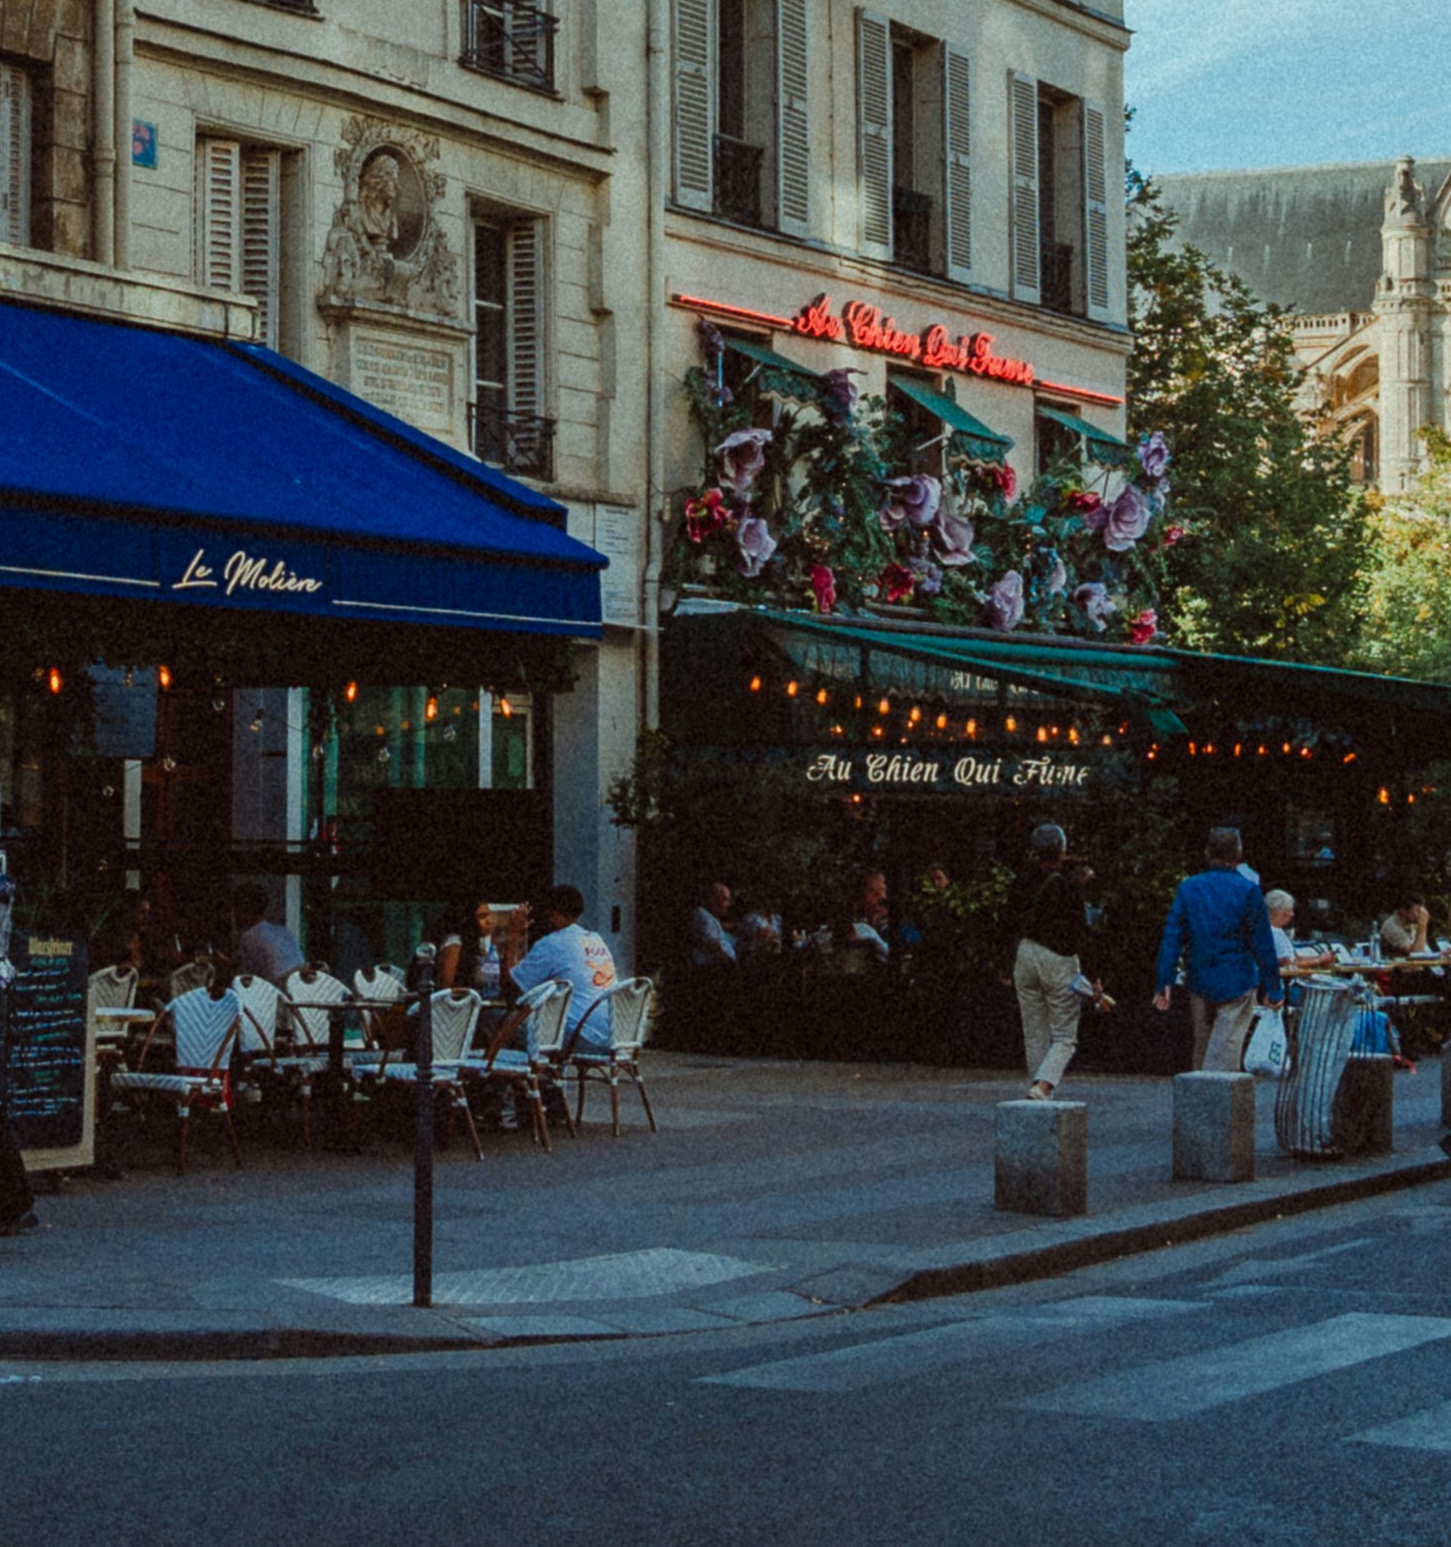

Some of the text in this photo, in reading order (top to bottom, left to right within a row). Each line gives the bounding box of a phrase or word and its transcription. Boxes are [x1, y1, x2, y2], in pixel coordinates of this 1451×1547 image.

[845, 299, 921, 357] Chien
[923, 323, 969, 368] Qui
[970, 331, 1035, 384] Fume
[172, 548, 323, 595] Le Molière
[805, 754, 852, 782] Au
[865, 753, 939, 783] Chien
[953, 756, 1002, 786] Qui
